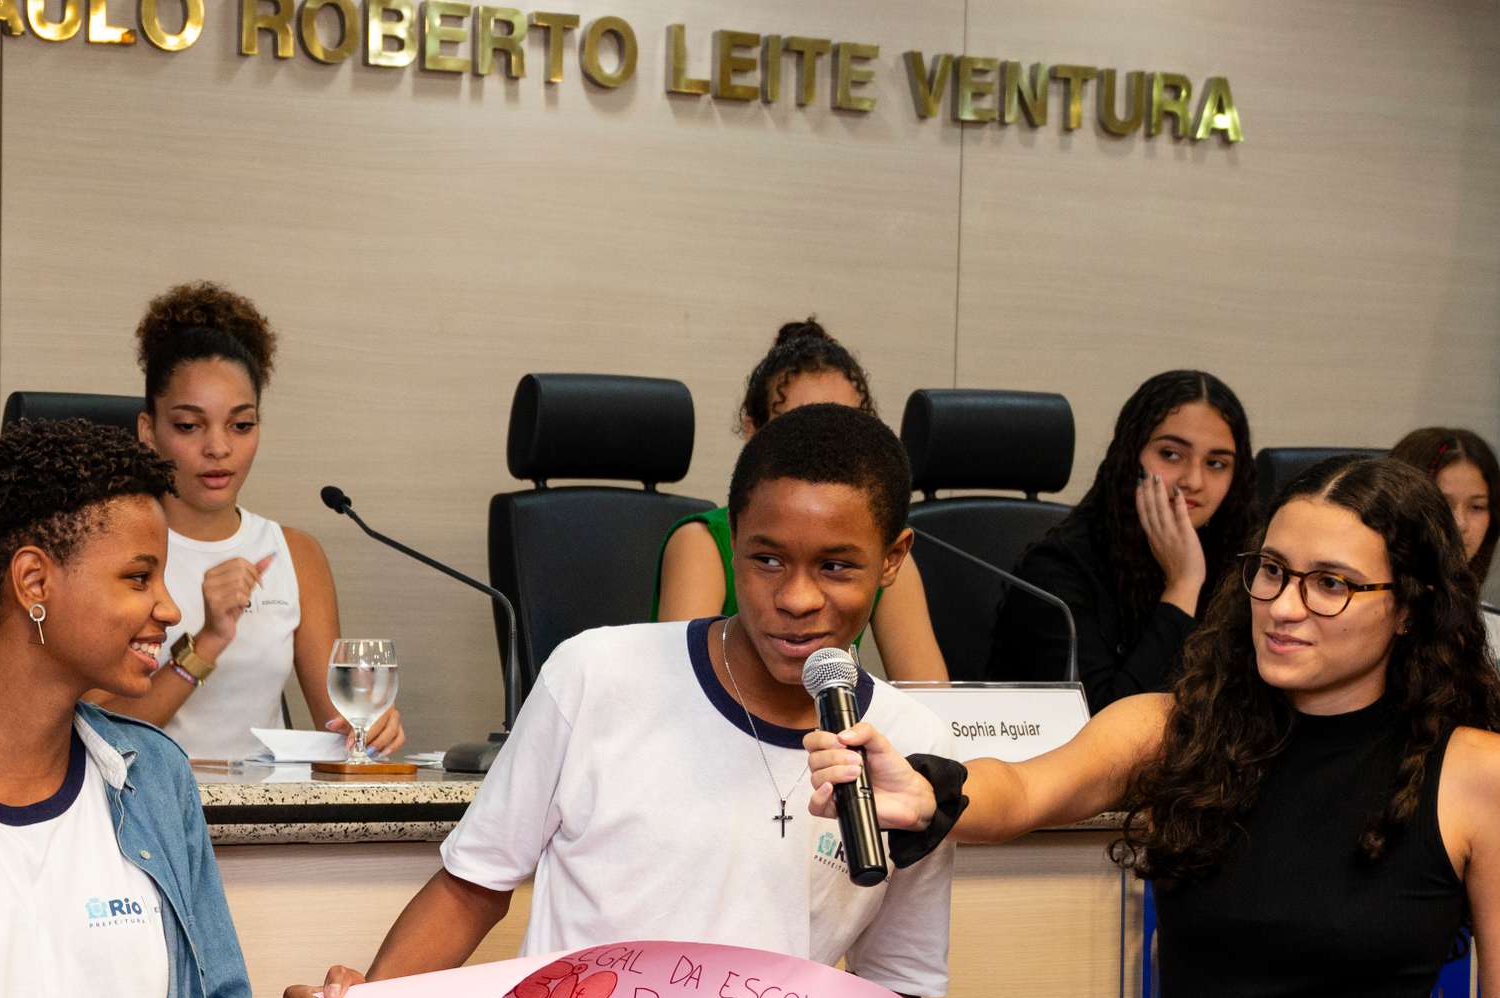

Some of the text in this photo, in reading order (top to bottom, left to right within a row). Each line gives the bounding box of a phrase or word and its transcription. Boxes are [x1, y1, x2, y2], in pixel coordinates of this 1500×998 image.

[238, 0, 639, 90] ROBERTO
[664, 23, 880, 113] LEITE
[902, 50, 1246, 144] VENTURA
[952, 720, 1041, 741] Sophia Aguiar
[108, 897, 142, 917] Rio
[670, 954, 706, 990] DA
